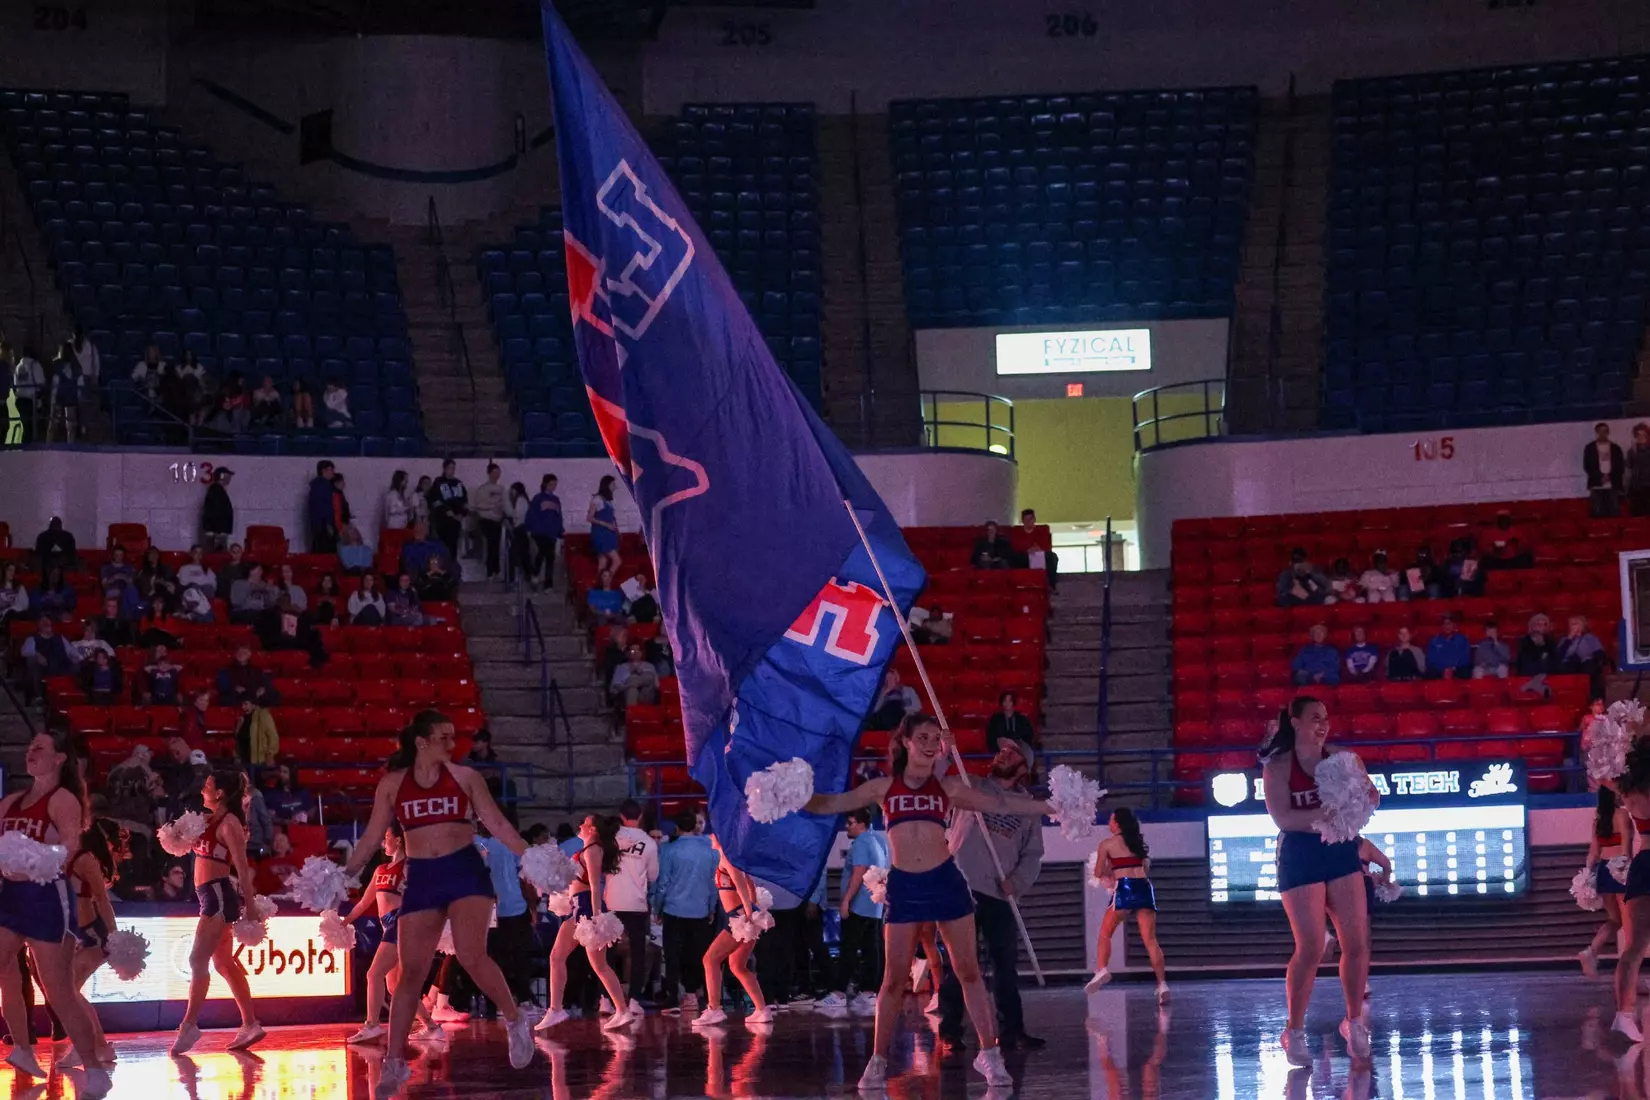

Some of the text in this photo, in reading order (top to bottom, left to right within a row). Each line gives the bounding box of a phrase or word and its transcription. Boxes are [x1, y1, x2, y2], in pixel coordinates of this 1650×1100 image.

[34, 7, 86, 31] 204
[1046, 10, 1098, 37] 206
[722, 21, 771, 45] 205
[1044, 337, 1135, 355] FYZICAL
[1410, 437, 1454, 460] 105
[169, 462, 213, 484] 103
[1391, 771, 1460, 795] TECH
[401, 796, 459, 820] TECH
[888, 794, 944, 814] TECH
[375, 874, 397, 886] ECH
